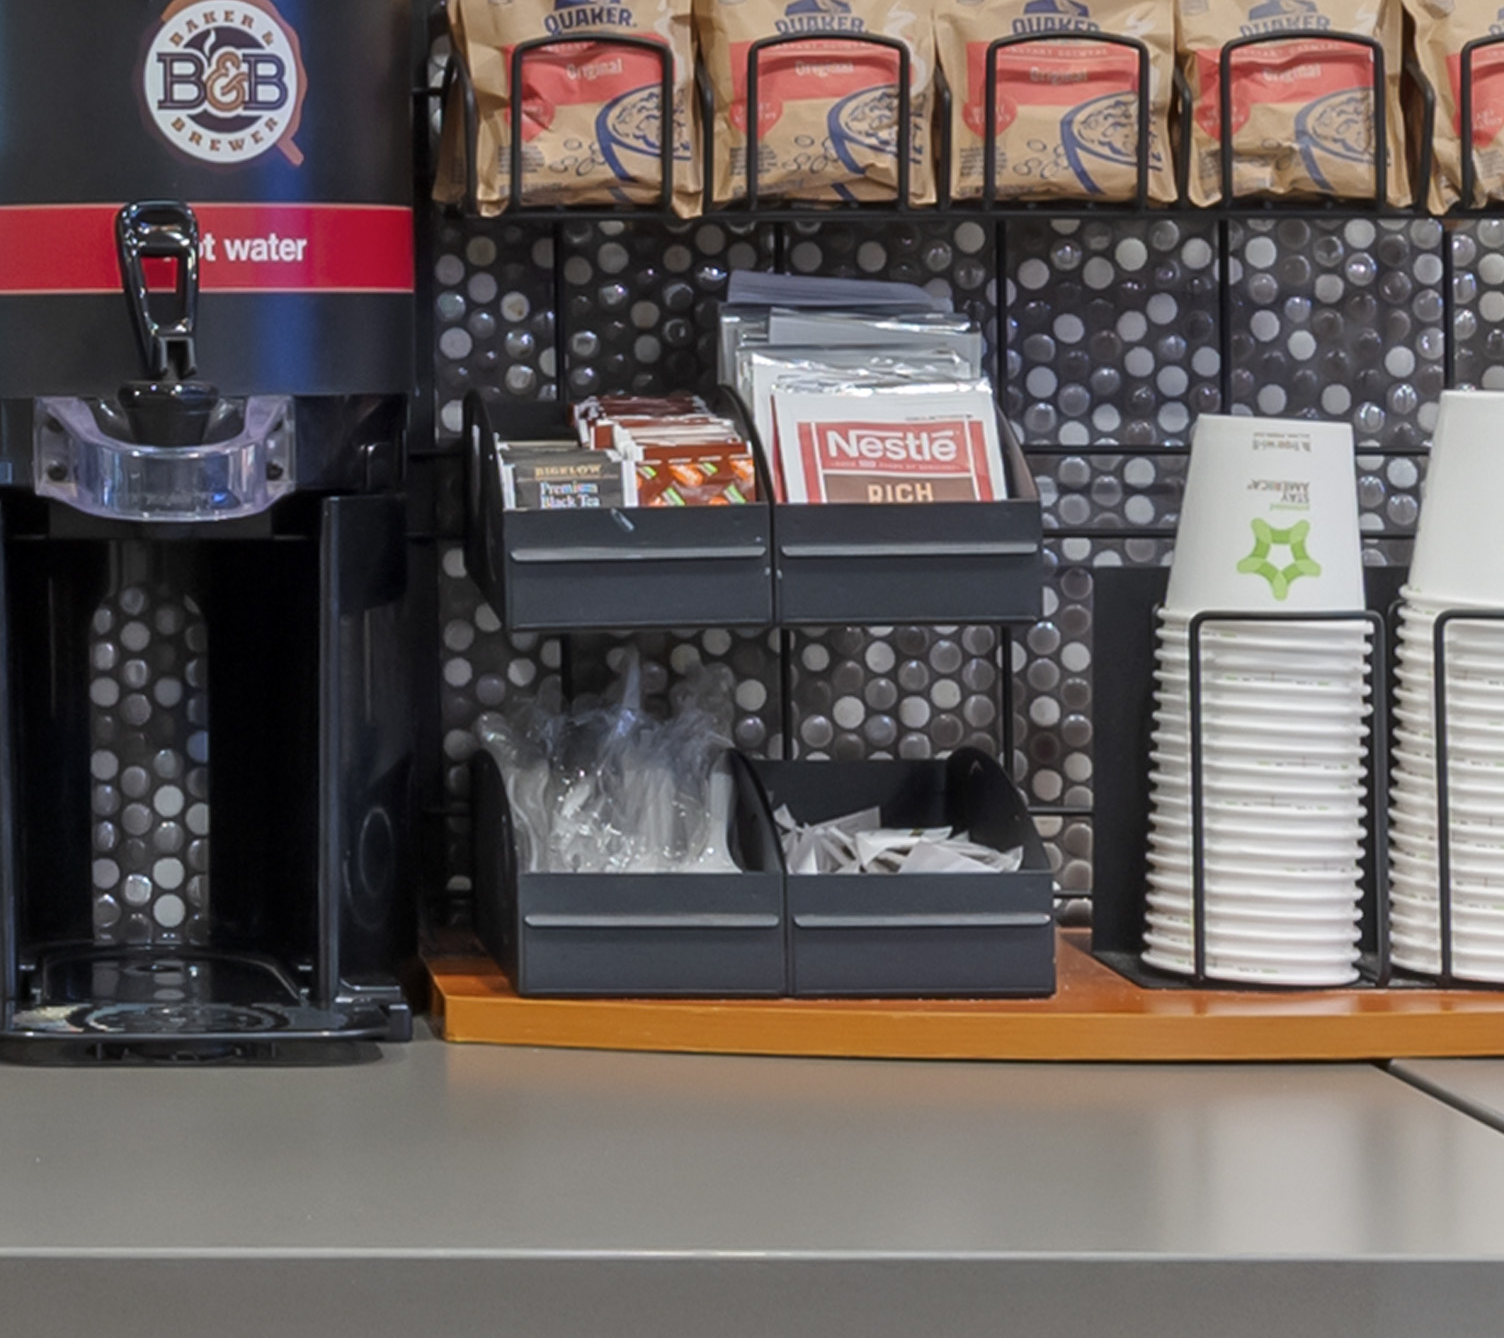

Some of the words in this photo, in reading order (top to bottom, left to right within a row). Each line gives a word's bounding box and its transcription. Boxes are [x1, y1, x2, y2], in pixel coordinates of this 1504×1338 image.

[169, 10, 256, 48] BAKER
[545, 7, 633, 37] QUAKER
[156, 51, 289, 111] B&B
[171, 117, 279, 152] BREWER
[223, 233, 307, 262] water
[826, 429, 957, 461] Nestlé
[535, 465, 602, 477] BIGELOW
[540, 481, 598, 493] Premium
[579, 494, 600, 507] Tea
